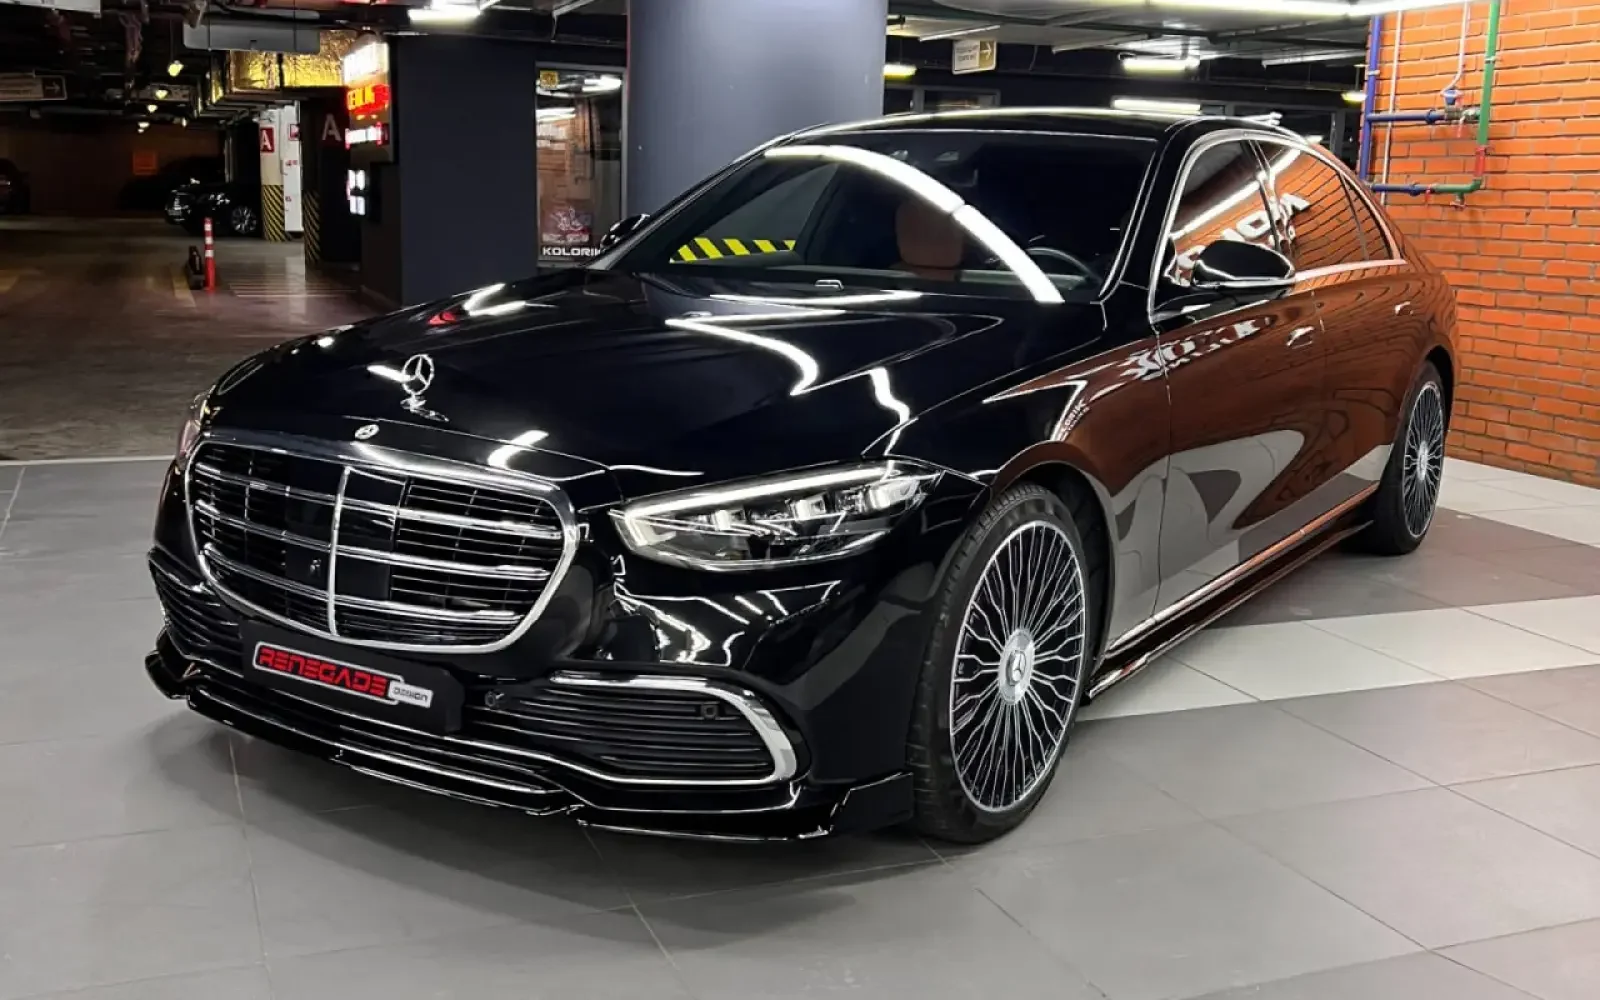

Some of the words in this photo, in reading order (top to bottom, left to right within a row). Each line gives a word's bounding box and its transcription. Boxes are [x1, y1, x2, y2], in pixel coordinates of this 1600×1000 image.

[260, 129, 272, 151] A
[322, 114, 342, 142] A
[259, 645, 388, 697] RENEGADE
